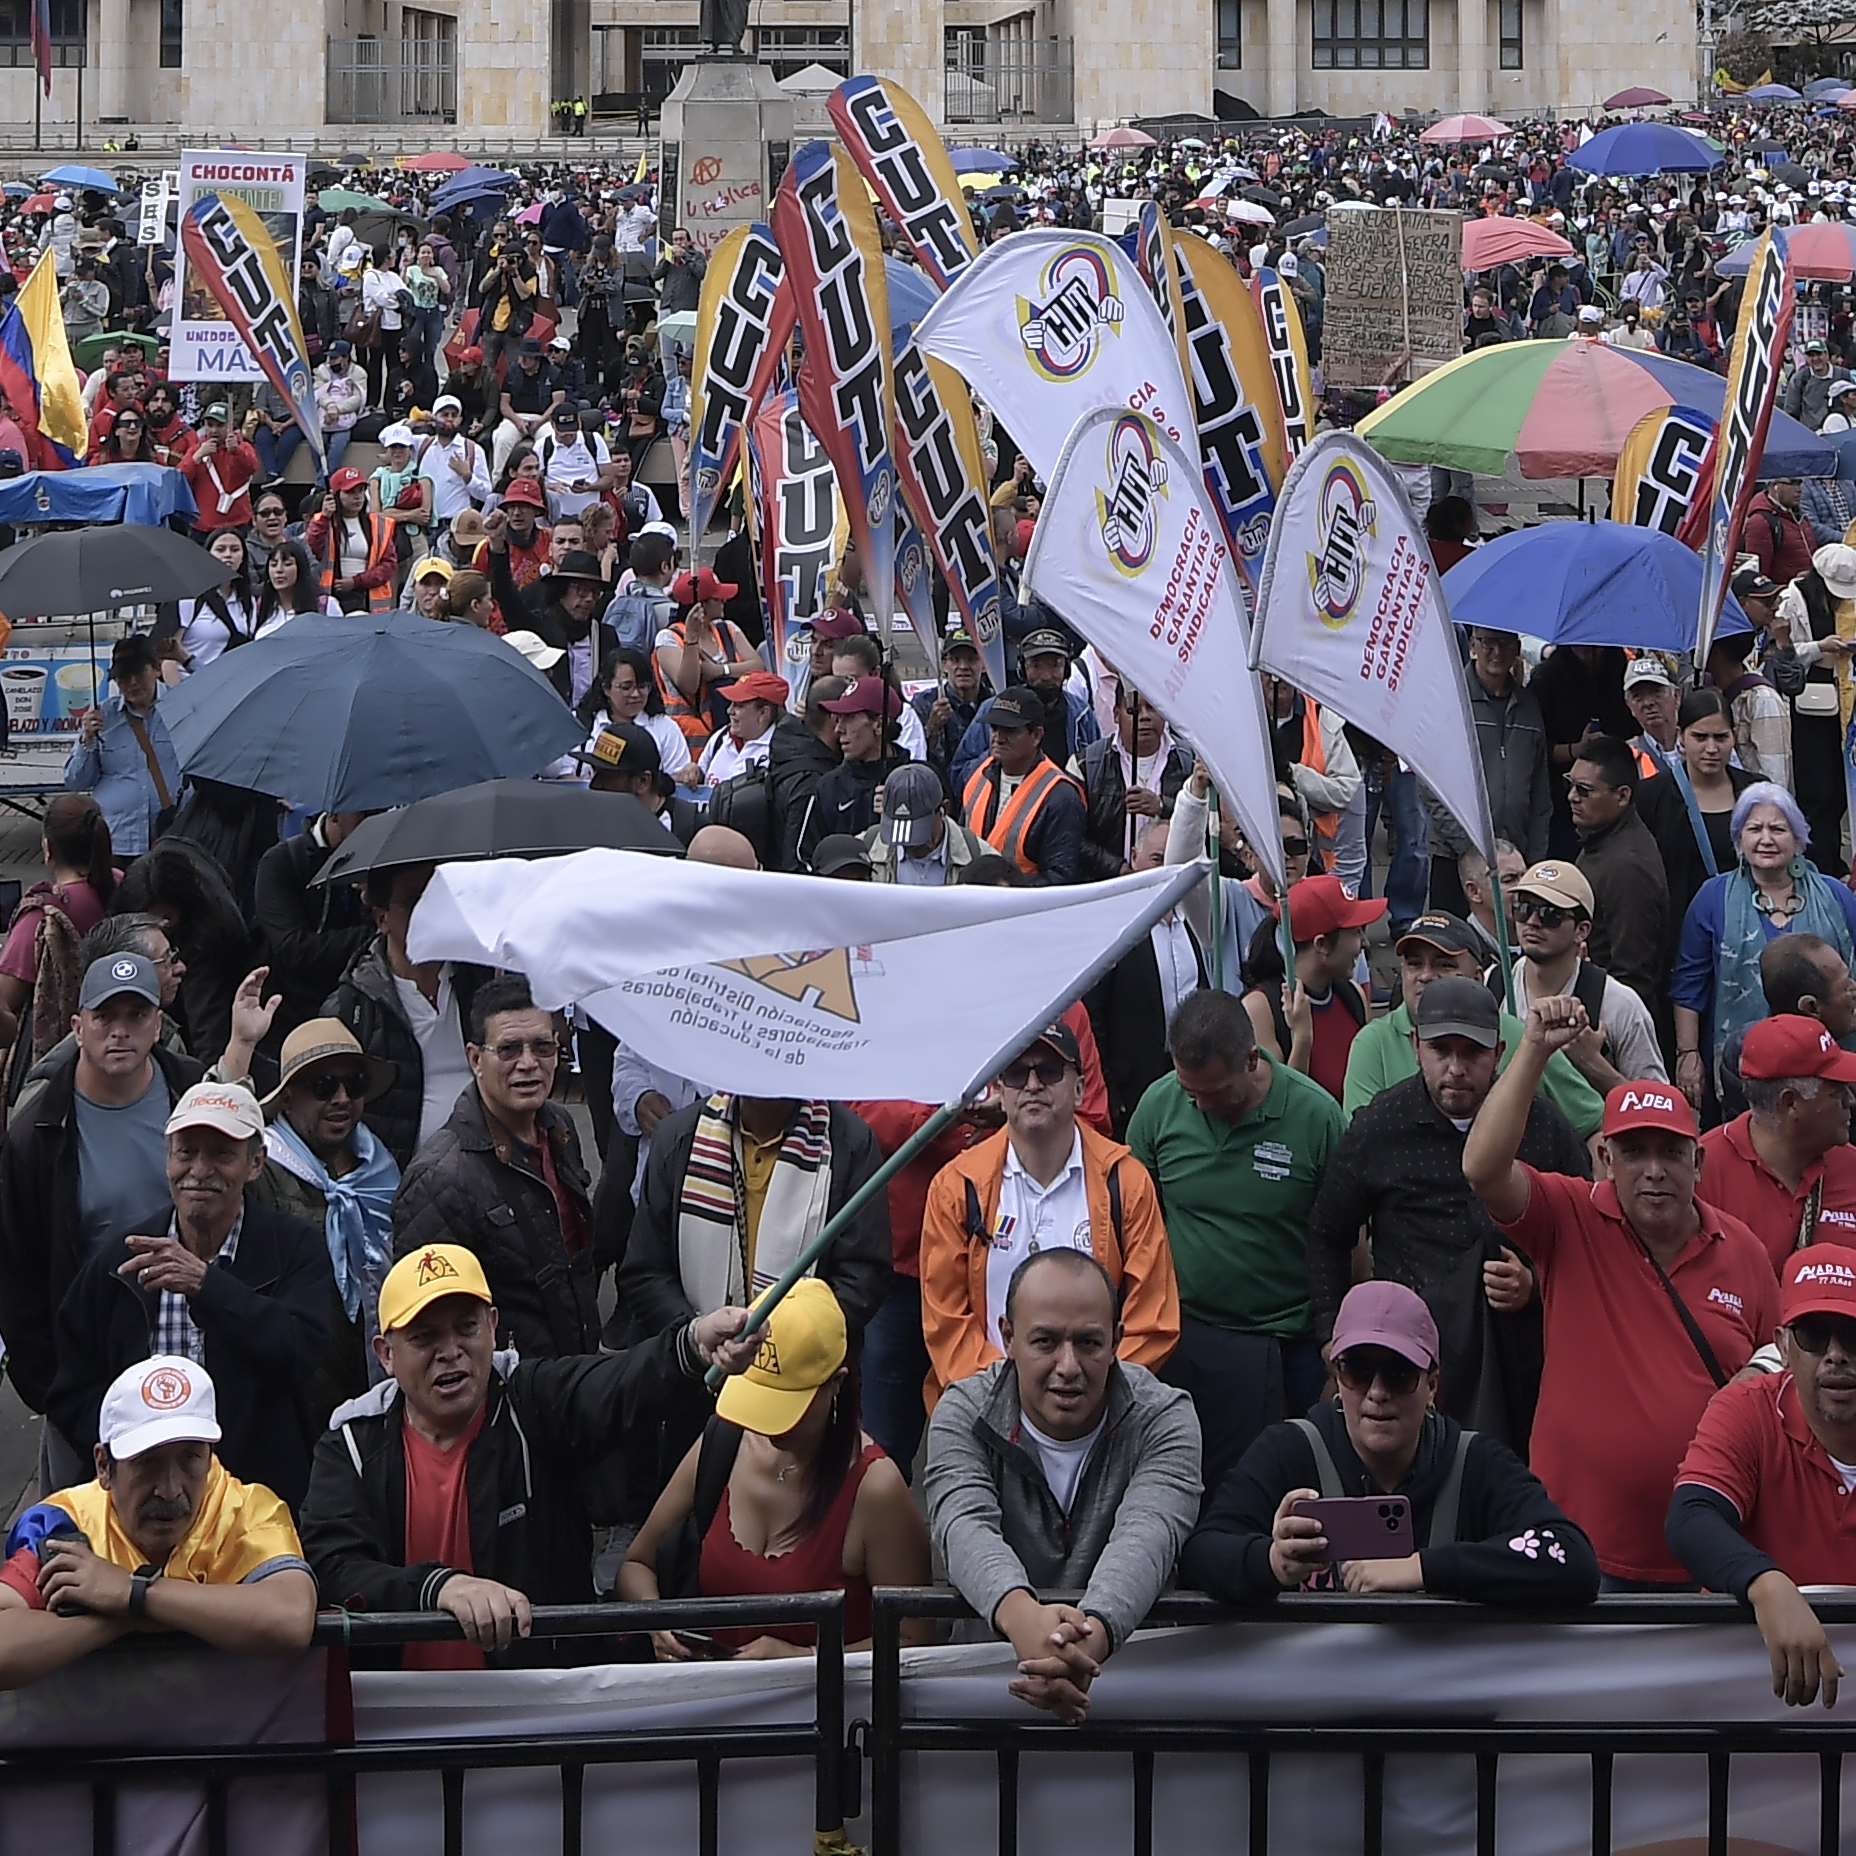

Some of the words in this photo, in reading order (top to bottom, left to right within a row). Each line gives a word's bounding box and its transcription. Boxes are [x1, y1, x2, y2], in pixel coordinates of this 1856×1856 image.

[140, 182, 161, 241] SES
[192, 163, 294, 182] CHOCONTÁ
[850, 87, 973, 280] CUT
[201, 206, 299, 375] CUT
[702, 232, 785, 459] CUT
[799, 158, 887, 467] CUT
[1722, 240, 1785, 516] CUT
[775, 407, 834, 622] CUT
[895, 345, 994, 600] CUT
[1634, 417, 1714, 535] CU
[1149, 507, 1201, 640] DEMOCRACIA
[1166, 530, 1211, 647] GARANTIAS
[1178, 543, 1226, 663] SINDICALES
[1360, 535, 1408, 681] DEMOCRACIA
[1376, 552, 1417, 681] GARANTIAS
[1387, 560, 1430, 692] SINDICALES
